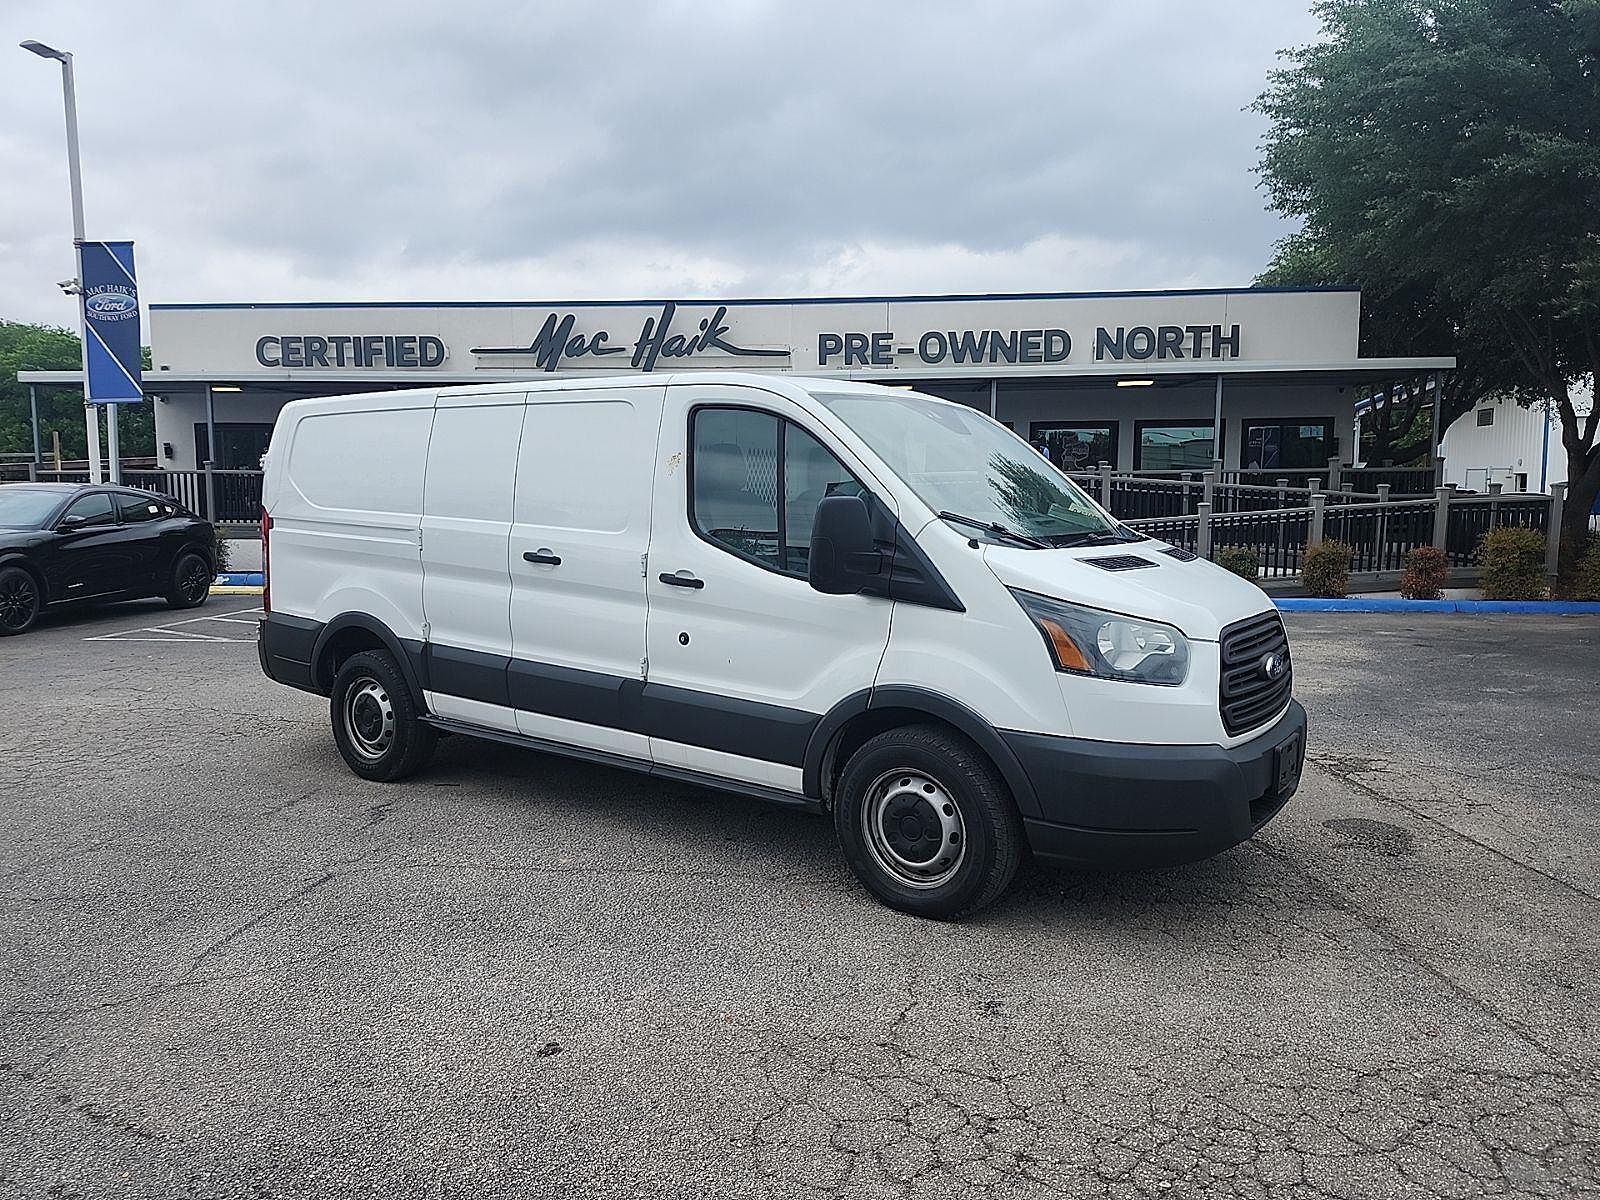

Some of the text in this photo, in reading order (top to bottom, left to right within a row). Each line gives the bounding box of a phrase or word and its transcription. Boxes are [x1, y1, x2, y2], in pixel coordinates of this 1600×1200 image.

[86, 284, 137, 298] MAC HAIK'S
[95, 298, 126, 311] Ford
[255, 335, 446, 368] CERTIFIED
[469, 301, 792, 373] Mac Haik
[817, 323, 1241, 366] PRE-OWNED NORTH
